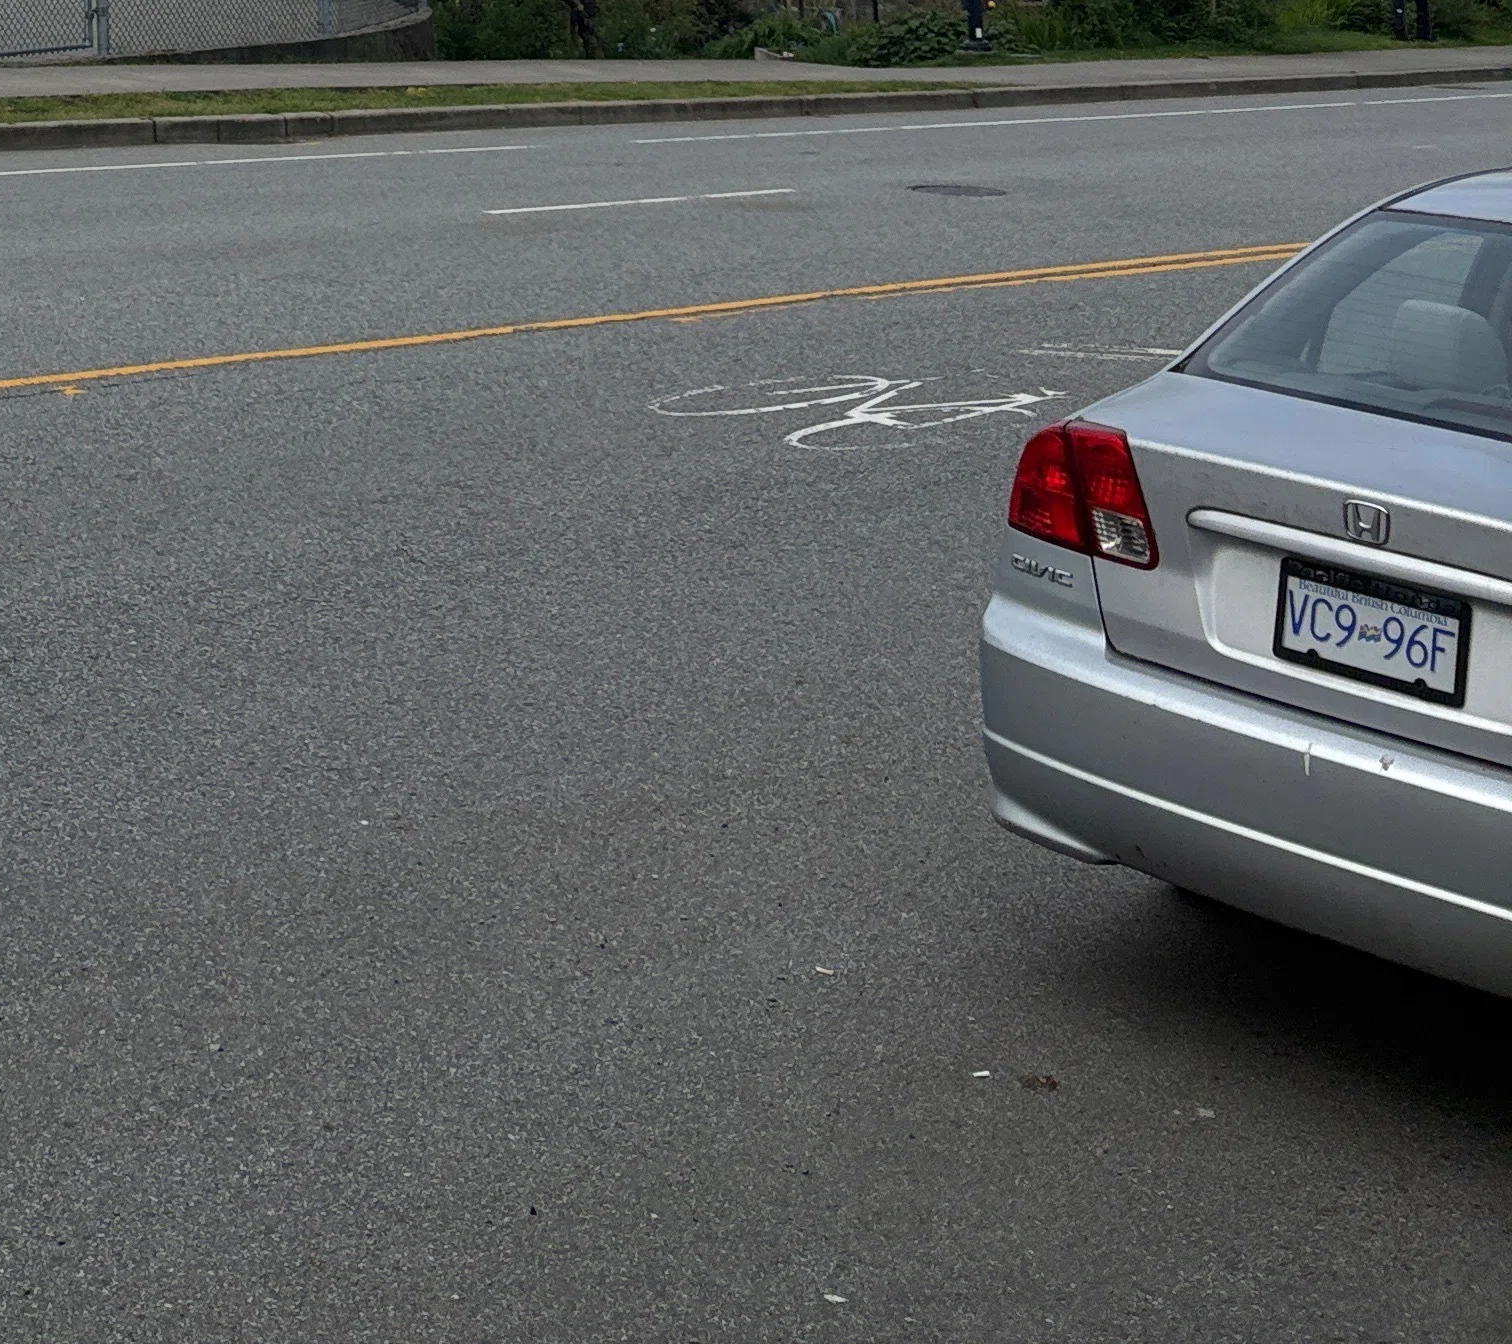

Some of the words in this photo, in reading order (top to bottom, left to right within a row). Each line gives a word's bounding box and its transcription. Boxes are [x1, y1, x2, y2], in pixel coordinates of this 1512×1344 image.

[1011, 553, 1073, 588] CIVIC
[1298, 578, 1349, 602] Beautiful
[1352, 593, 1389, 612] British
[1390, 603, 1449, 628] Columbia
[1289, 589, 1357, 648] VC9
[1383, 616, 1456, 673] 96F
